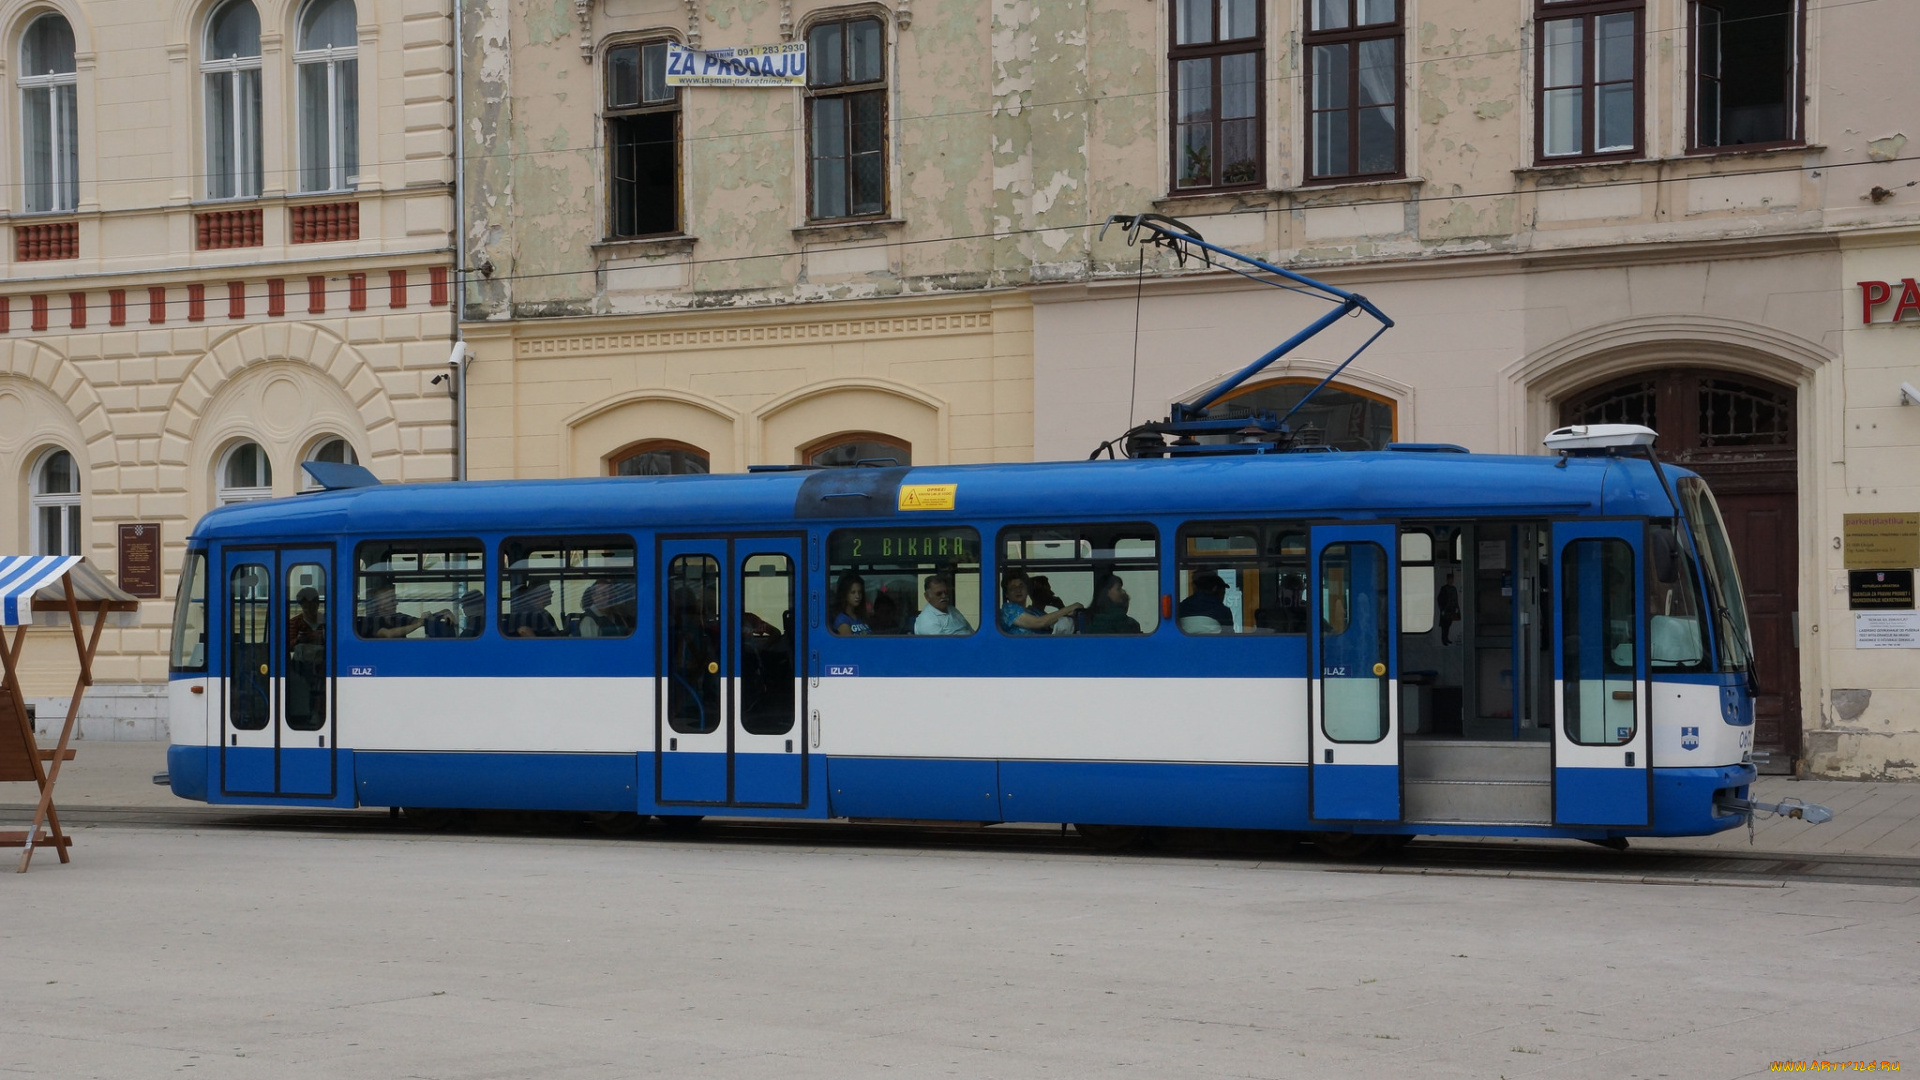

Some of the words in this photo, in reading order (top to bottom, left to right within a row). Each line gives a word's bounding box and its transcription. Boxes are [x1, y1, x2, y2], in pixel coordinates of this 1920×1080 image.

[737, 48, 754, 56] 091
[762, 46, 779, 55] 283
[782, 43, 805, 53] 2930
[668, 52, 696, 75] ZA
[702, 52, 806, 77] PRODAJU
[679, 76, 793, 85] www.tasman-nekretnine.hr
[853, 538, 862, 557] 2
[882, 537, 964, 556] BIKARA
[1833, 536, 1841, 550] 3
[352, 667, 372, 676] IZLAZ
[830, 667, 854, 675] IZLAZ
